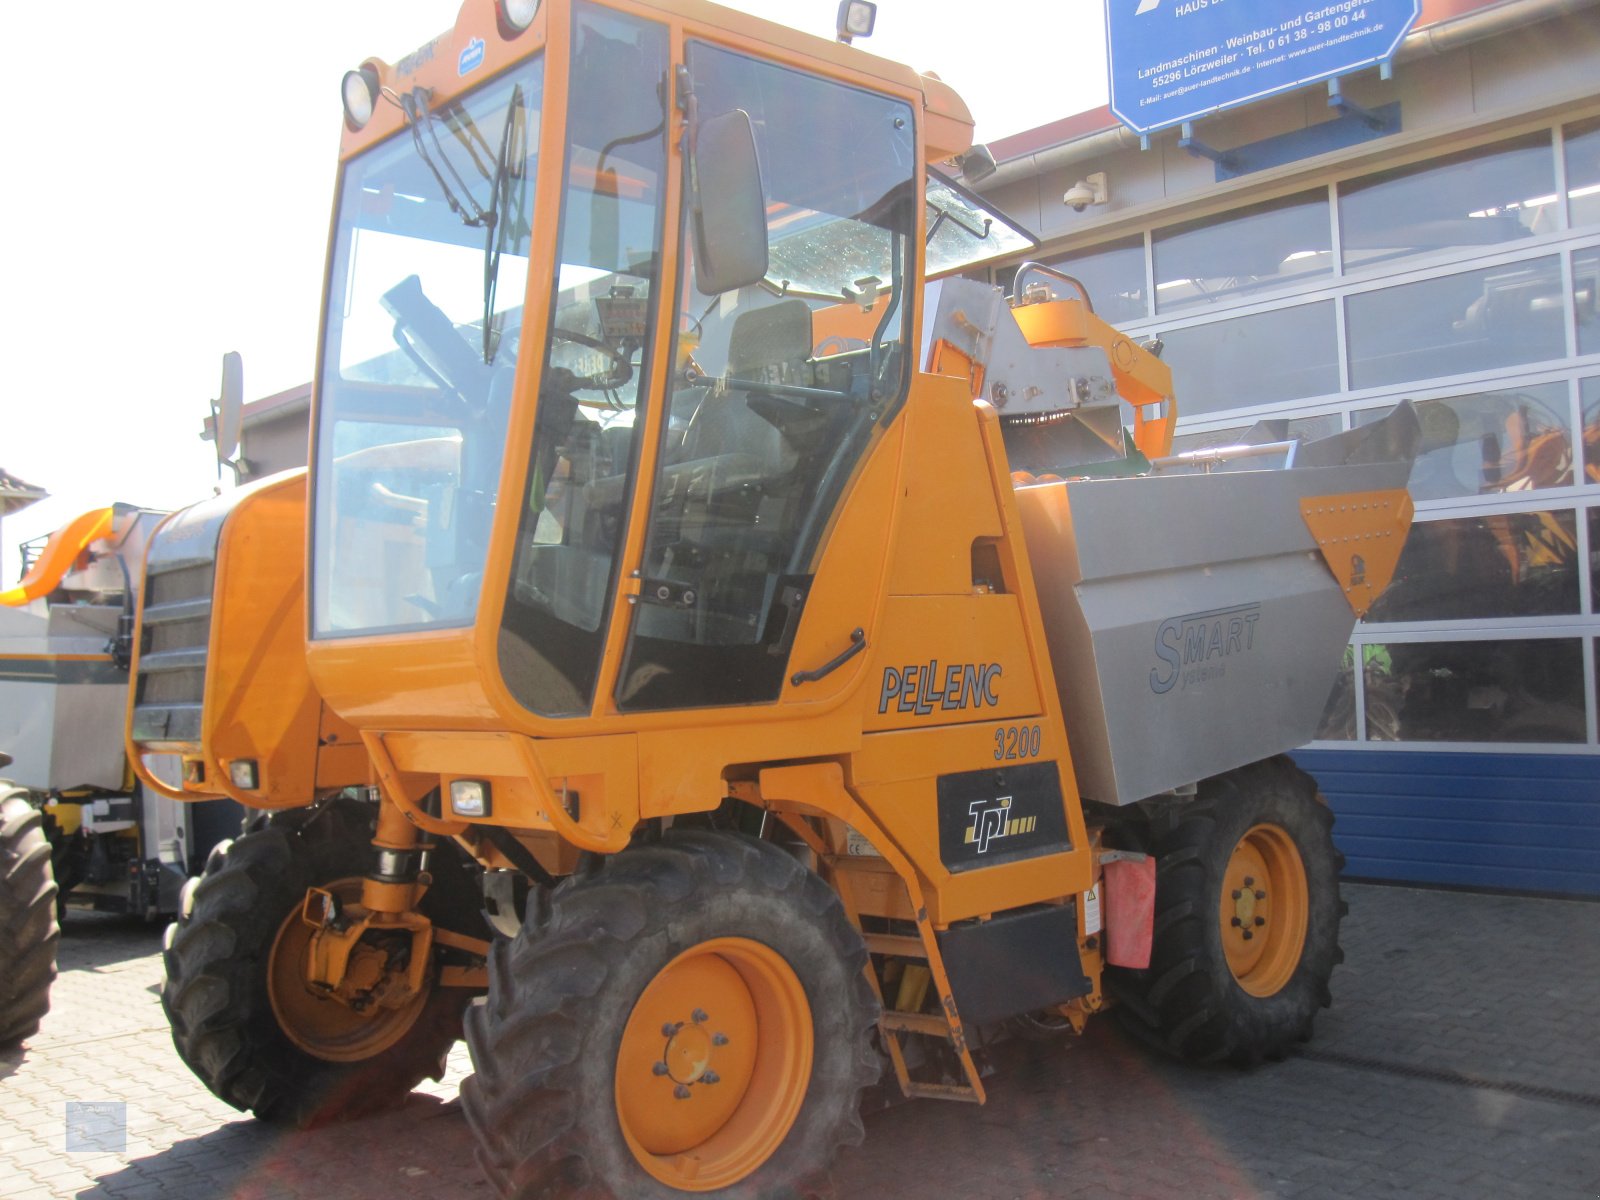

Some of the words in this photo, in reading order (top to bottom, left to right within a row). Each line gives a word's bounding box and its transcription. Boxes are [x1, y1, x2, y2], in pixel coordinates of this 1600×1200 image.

[1175, 0, 1208, 17] HAUS
[1138, 45, 1218, 79] Landmaschinen
[1226, 27, 1278, 49] Weinbau-
[1280, 15, 1302, 31] und
[1139, 94, 1163, 107] E-Mail:
[1256, 53, 1286, 69] Internet:
[1287, 23, 1384, 59] www.auer-landtechnik.de
[1152, 70, 1182, 88] 55296
[1184, 53, 1238, 78] Lörzweiler
[1246, 43, 1266, 57] Tel.
[1268, 39, 1275, 50] 0
[1278, 34, 1291, 47] 61
[1294, 28, 1308, 41] 38
[1317, 20, 1331, 33] 98
[1334, 15, 1348, 28] 00
[1351, 9, 1366, 22] 44
[1150, 601, 1261, 694] SMART
[878, 659, 1003, 715] PELLENC
[994, 725, 1041, 760] 3200
